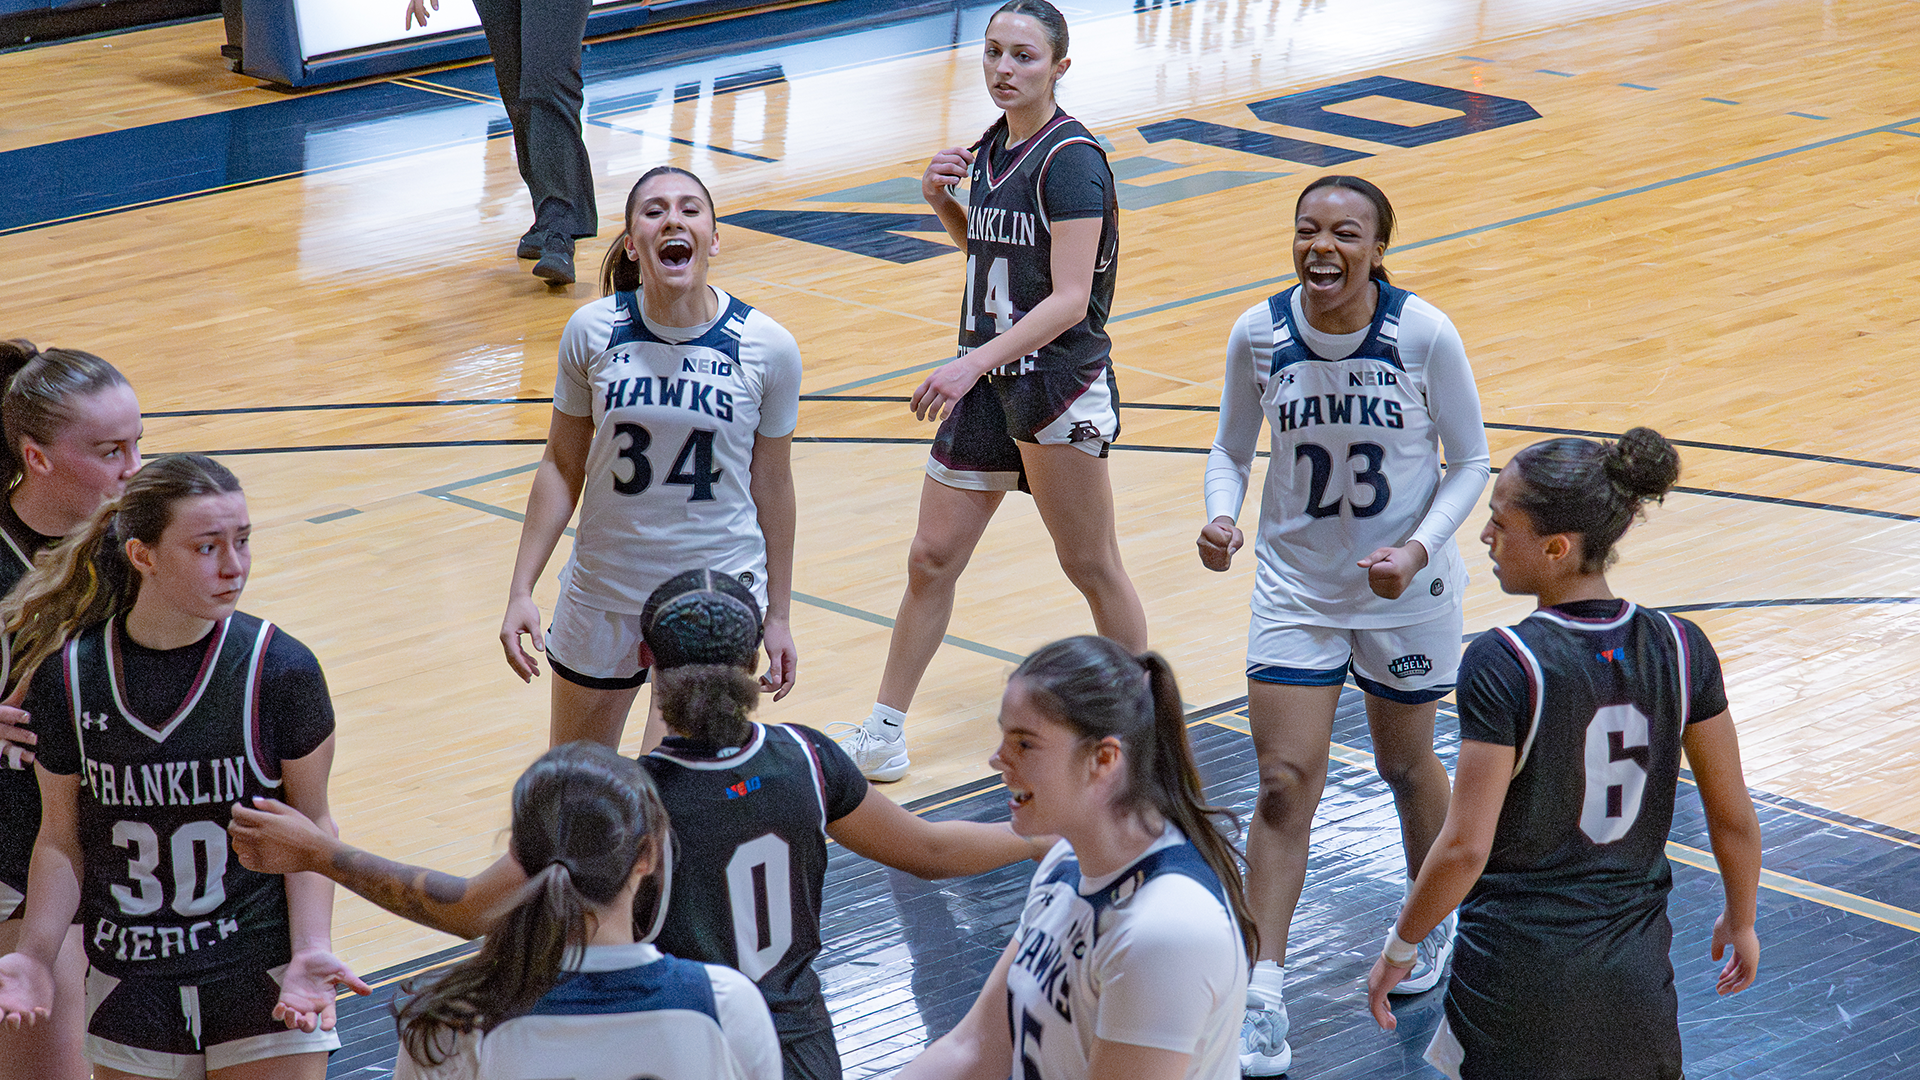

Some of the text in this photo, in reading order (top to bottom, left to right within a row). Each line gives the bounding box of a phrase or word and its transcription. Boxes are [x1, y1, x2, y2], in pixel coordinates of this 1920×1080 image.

[967, 205, 1035, 247] ANKLIN
[965, 254, 1013, 334] 14
[681, 357, 732, 377] NE10
[1349, 371, 1398, 387] NE10
[604, 376, 733, 423] HAWKS
[1278, 394, 1404, 432] HAWKS
[611, 420, 724, 503] 34
[1294, 441, 1392, 520] 23
[86, 756, 245, 806] FRANKLIN
[1579, 703, 1649, 845] 6
[110, 820, 228, 917] 30
[725, 832, 793, 983] 0
